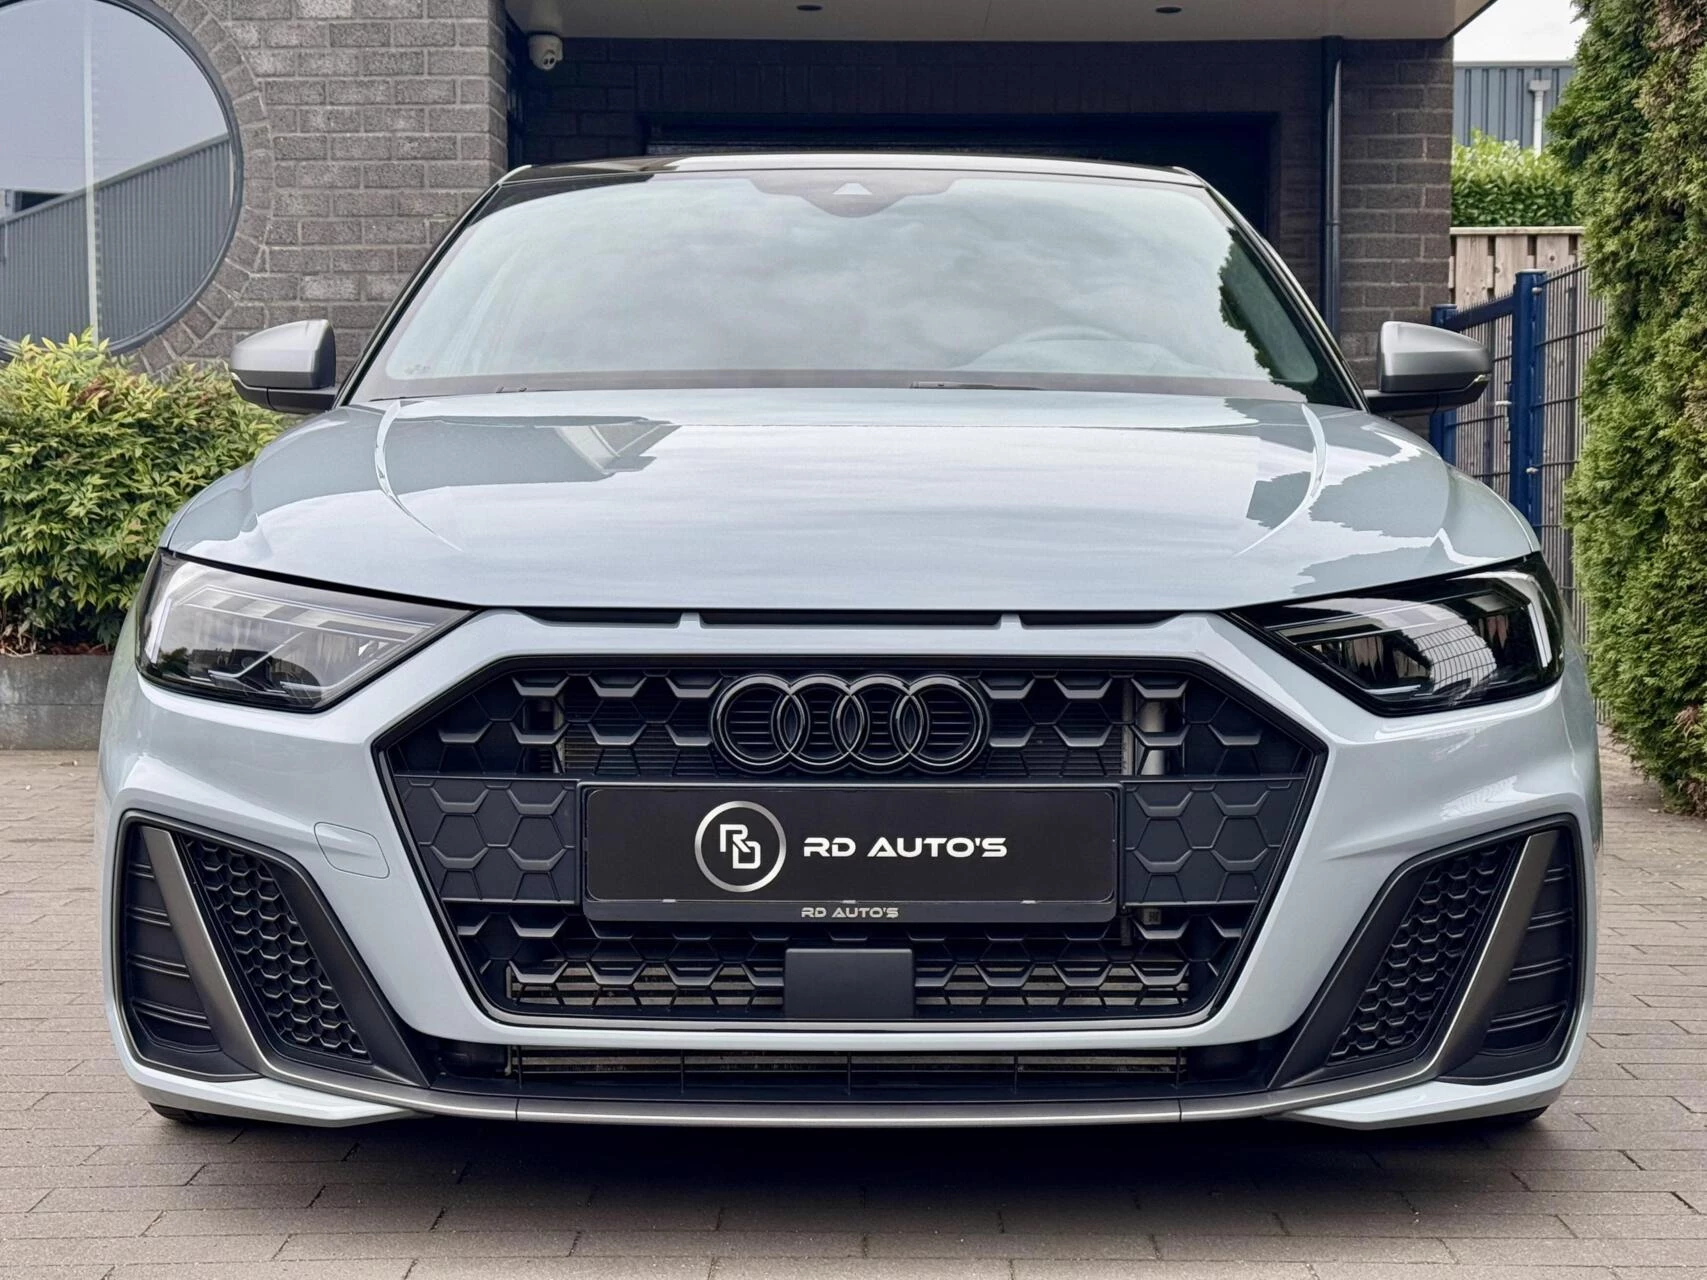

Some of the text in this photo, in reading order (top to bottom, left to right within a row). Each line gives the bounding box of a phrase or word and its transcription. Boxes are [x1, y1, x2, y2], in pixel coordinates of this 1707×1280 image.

[719, 823, 761, 869] RD
[803, 837, 1007, 858] RD AUTO'S
[800, 907, 899, 918] RD AUTO'S
